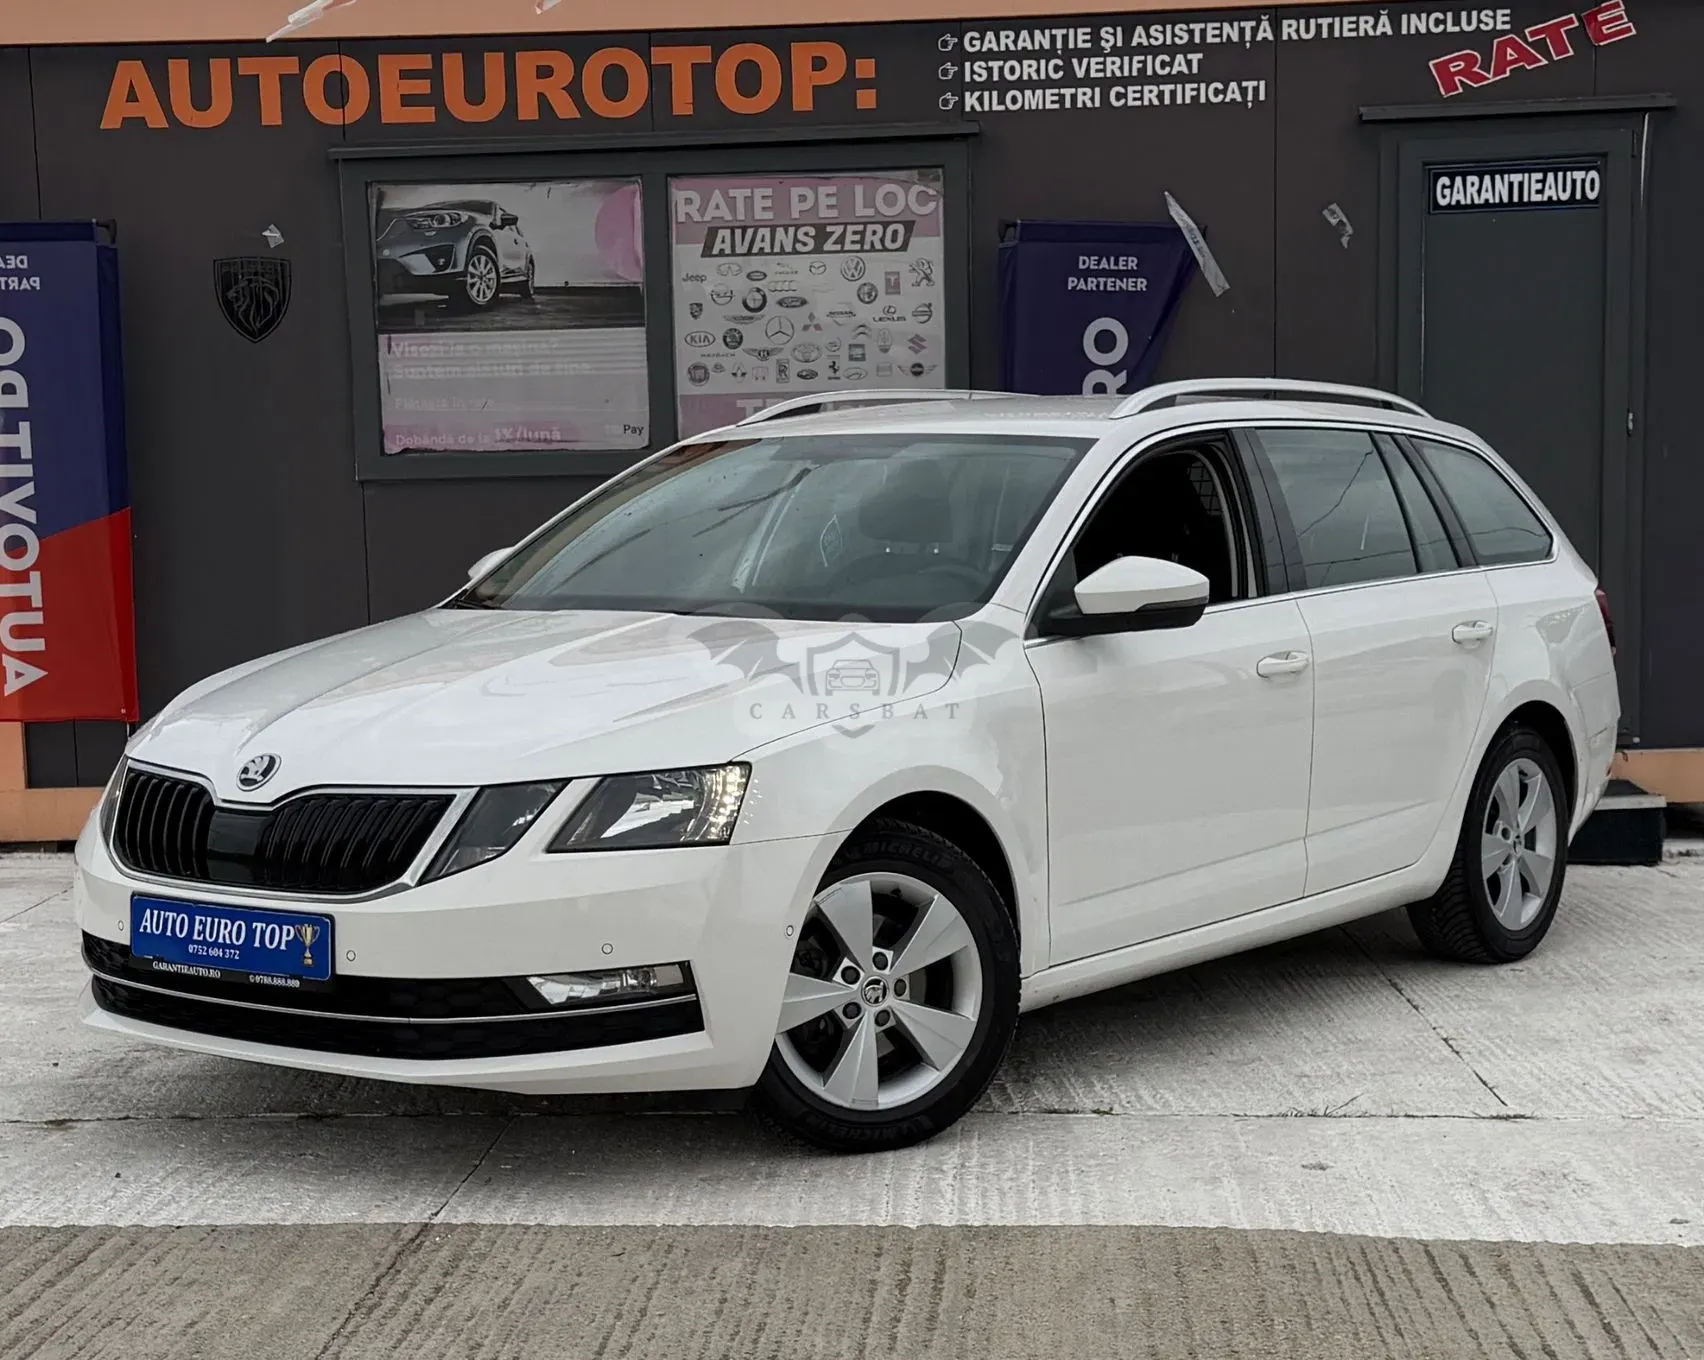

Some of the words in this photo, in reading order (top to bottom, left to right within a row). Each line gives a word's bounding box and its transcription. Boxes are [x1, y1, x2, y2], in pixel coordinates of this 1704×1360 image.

[1131, 15, 1275, 49] ASISTENȚĂ
[1281, 11, 1393, 42] RUTIERĂ
[1400, 9, 1511, 35] INCLUSE
[1428, 0, 1637, 98] RATE
[964, 59, 1065, 83] ISTORIC
[1072, 52, 1204, 79] VERIFICAT
[100, 42, 877, 129] AUTOEUROTOP:
[964, 87, 1101, 112] KILOMETRI
[1109, 79, 1266, 109] CERTIFICAȚI
[676, 188, 774, 223] RATE
[790, 185, 840, 219] PE
[853, 183, 938, 217] LOC
[1435, 170, 1600, 207] GARANTIEAUTO
[711, 226, 817, 256] AVANS
[823, 223, 906, 252] ZERO
[1078, 256, 1138, 270] DEALER
[1067, 277, 1147, 291] PARTENER
[690, 332, 712, 345] KIA
[623, 424, 644, 436] Pay
[139, 908, 189, 939] AUTO
[192, 915, 246, 946] EURO
[252, 922, 295, 950] TOP
[188, 944, 207, 956] 0752
[224, 948, 240, 960] 372
